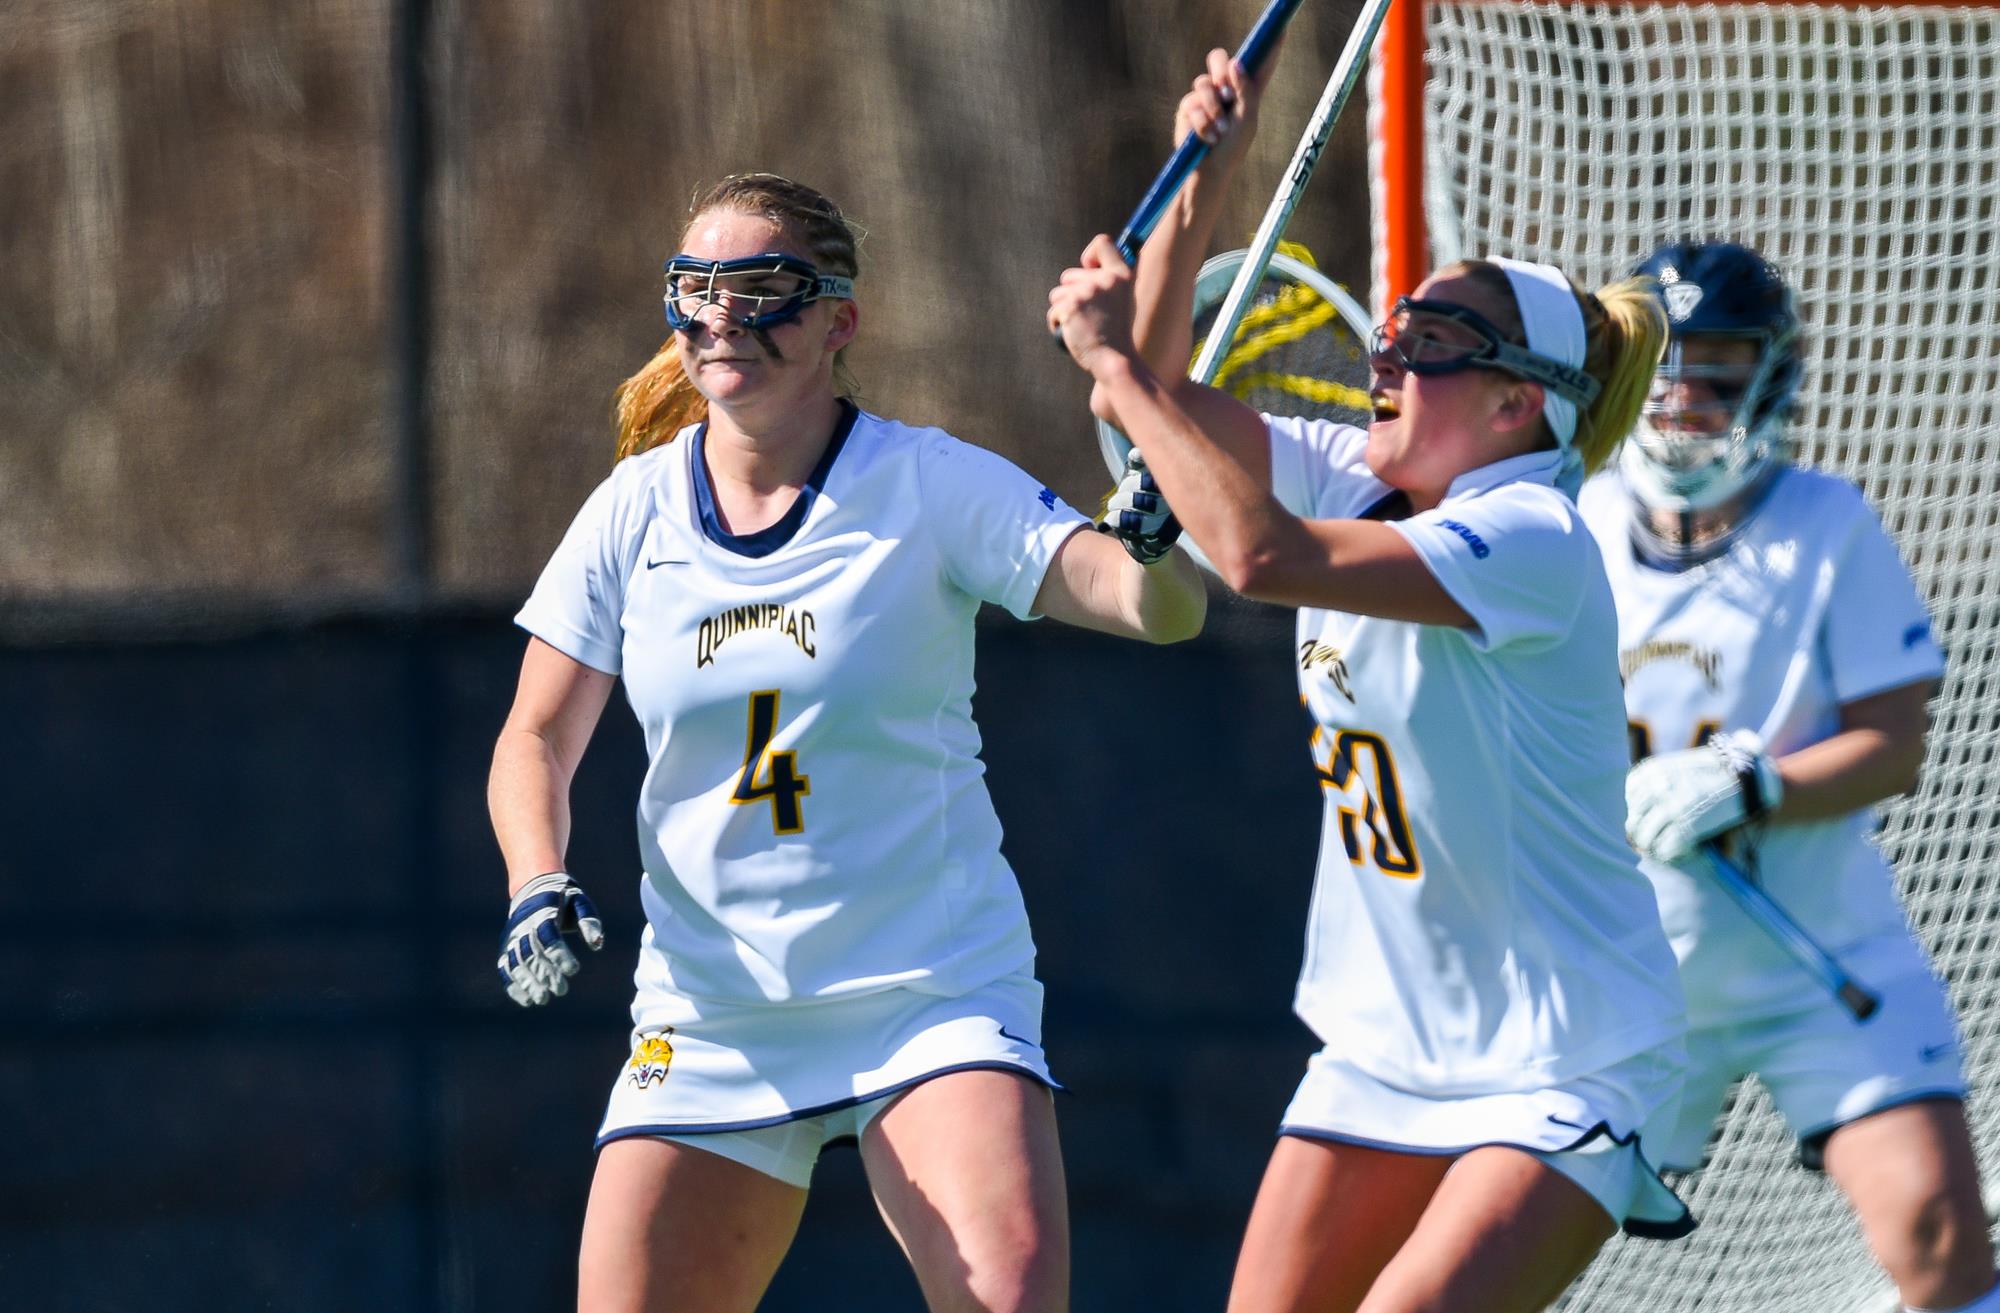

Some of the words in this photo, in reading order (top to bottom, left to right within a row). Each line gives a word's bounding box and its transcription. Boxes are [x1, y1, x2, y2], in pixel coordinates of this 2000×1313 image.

[1291, 132, 1325, 191] STX
[697, 603, 816, 669] QUINNIPIAC
[728, 688, 811, 836] 4
